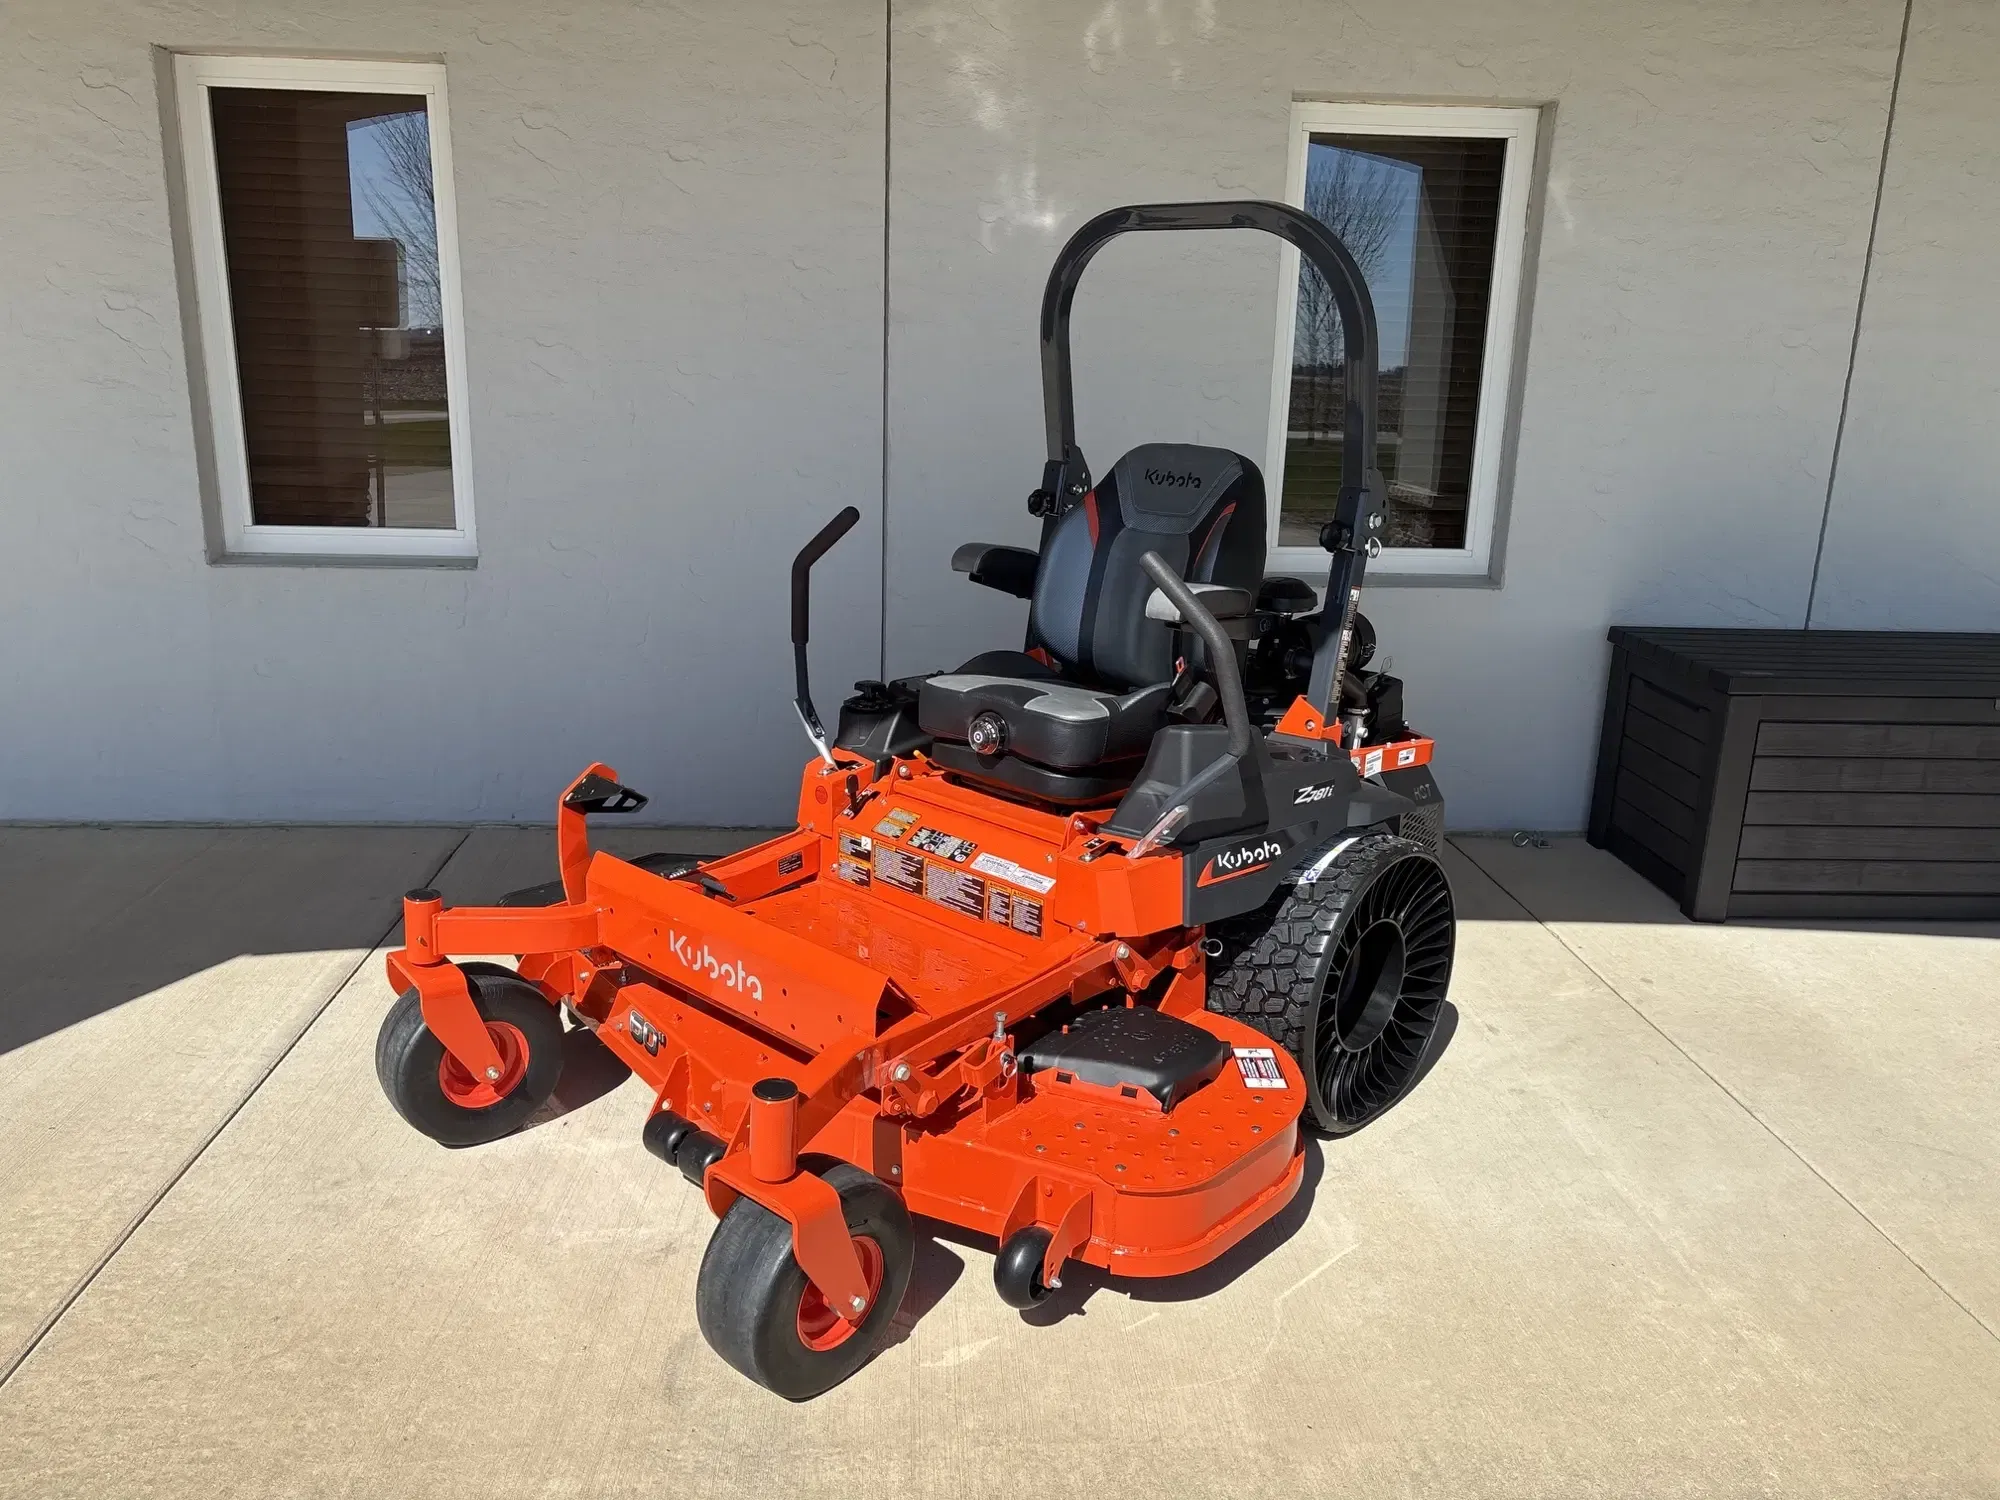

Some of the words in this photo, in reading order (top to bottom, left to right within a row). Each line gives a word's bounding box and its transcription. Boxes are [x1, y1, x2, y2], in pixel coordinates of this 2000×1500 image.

[1144, 468, 1202, 489] Kubota
[1217, 841, 1282, 869] Kubota
[669, 929, 764, 1002] Kubota
